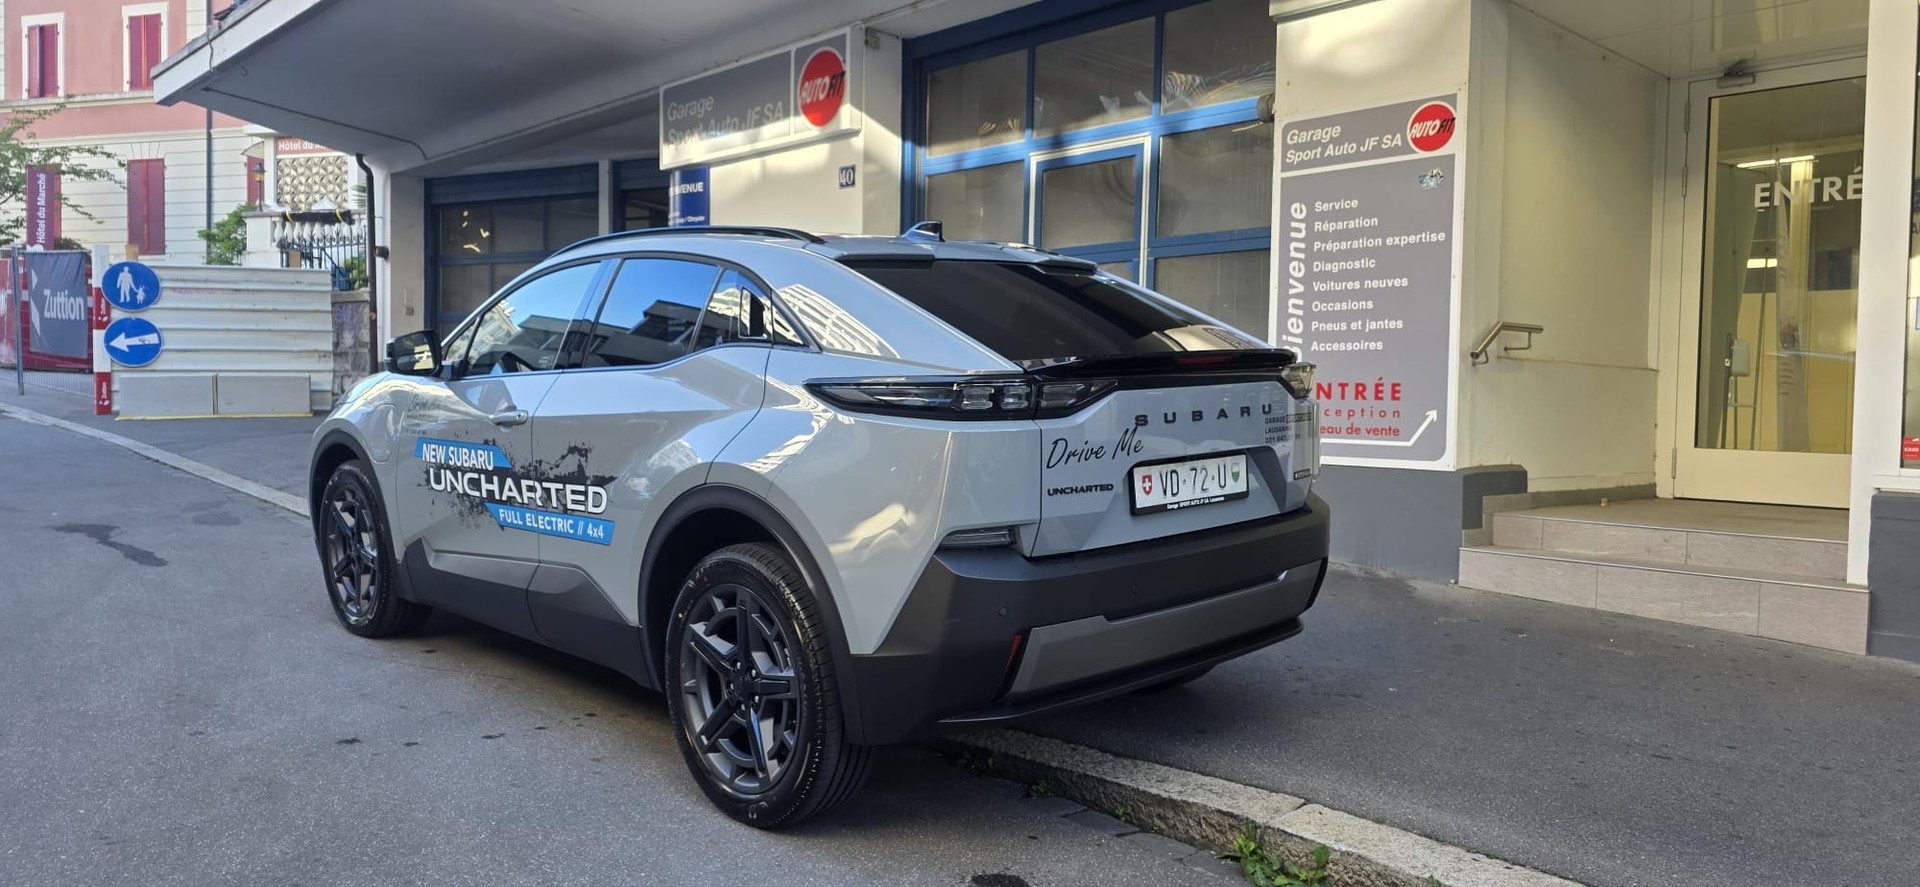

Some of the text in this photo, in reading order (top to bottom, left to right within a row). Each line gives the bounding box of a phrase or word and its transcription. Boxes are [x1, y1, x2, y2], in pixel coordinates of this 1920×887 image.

[801, 70, 846, 105] AUTOFIT
[667, 96, 714, 121] Garage
[763, 101, 784, 124] SA
[1286, 125, 1342, 145] Garage
[1409, 116, 1457, 139] AUTOFIT
[278, 140, 301, 151] Hôtel
[302, 140, 313, 150] du
[1285, 133, 1402, 165] Sport Auto JF SA
[839, 168, 854, 185] 40
[1754, 165, 1863, 208] ENTRÉ
[36, 172, 46, 244] Hôtel du Marché
[1314, 199, 1359, 212] Service
[1314, 216, 1379, 233] Réparation
[1313, 231, 1446, 253] Préparation expertise
[1313, 257, 1376, 273] Diagnostic
[1312, 277, 1409, 292] Voitures neuves
[43, 288, 85, 321] Zuttion
[1311, 299, 1374, 312] Occasions
[1311, 318, 1404, 332] Pneus et jantes
[1310, 340, 1384, 352] Accessoires
[1315, 376, 1402, 401] NTRÉE
[1134, 403, 1273, 427] SUBARU
[1323, 406, 1401, 420] ception
[1319, 422, 1400, 436] eau de vente
[422, 443, 494, 471] NEW SUBARU
[1046, 425, 1144, 469] Drive Me
[429, 467, 608, 515] UNCHARTED
[1047, 483, 1114, 497] UNCHARTED
[499, 508, 524, 526] FULL
[525, 515, 574, 534] ELECTRIC
[587, 525, 605, 539] 4x4
